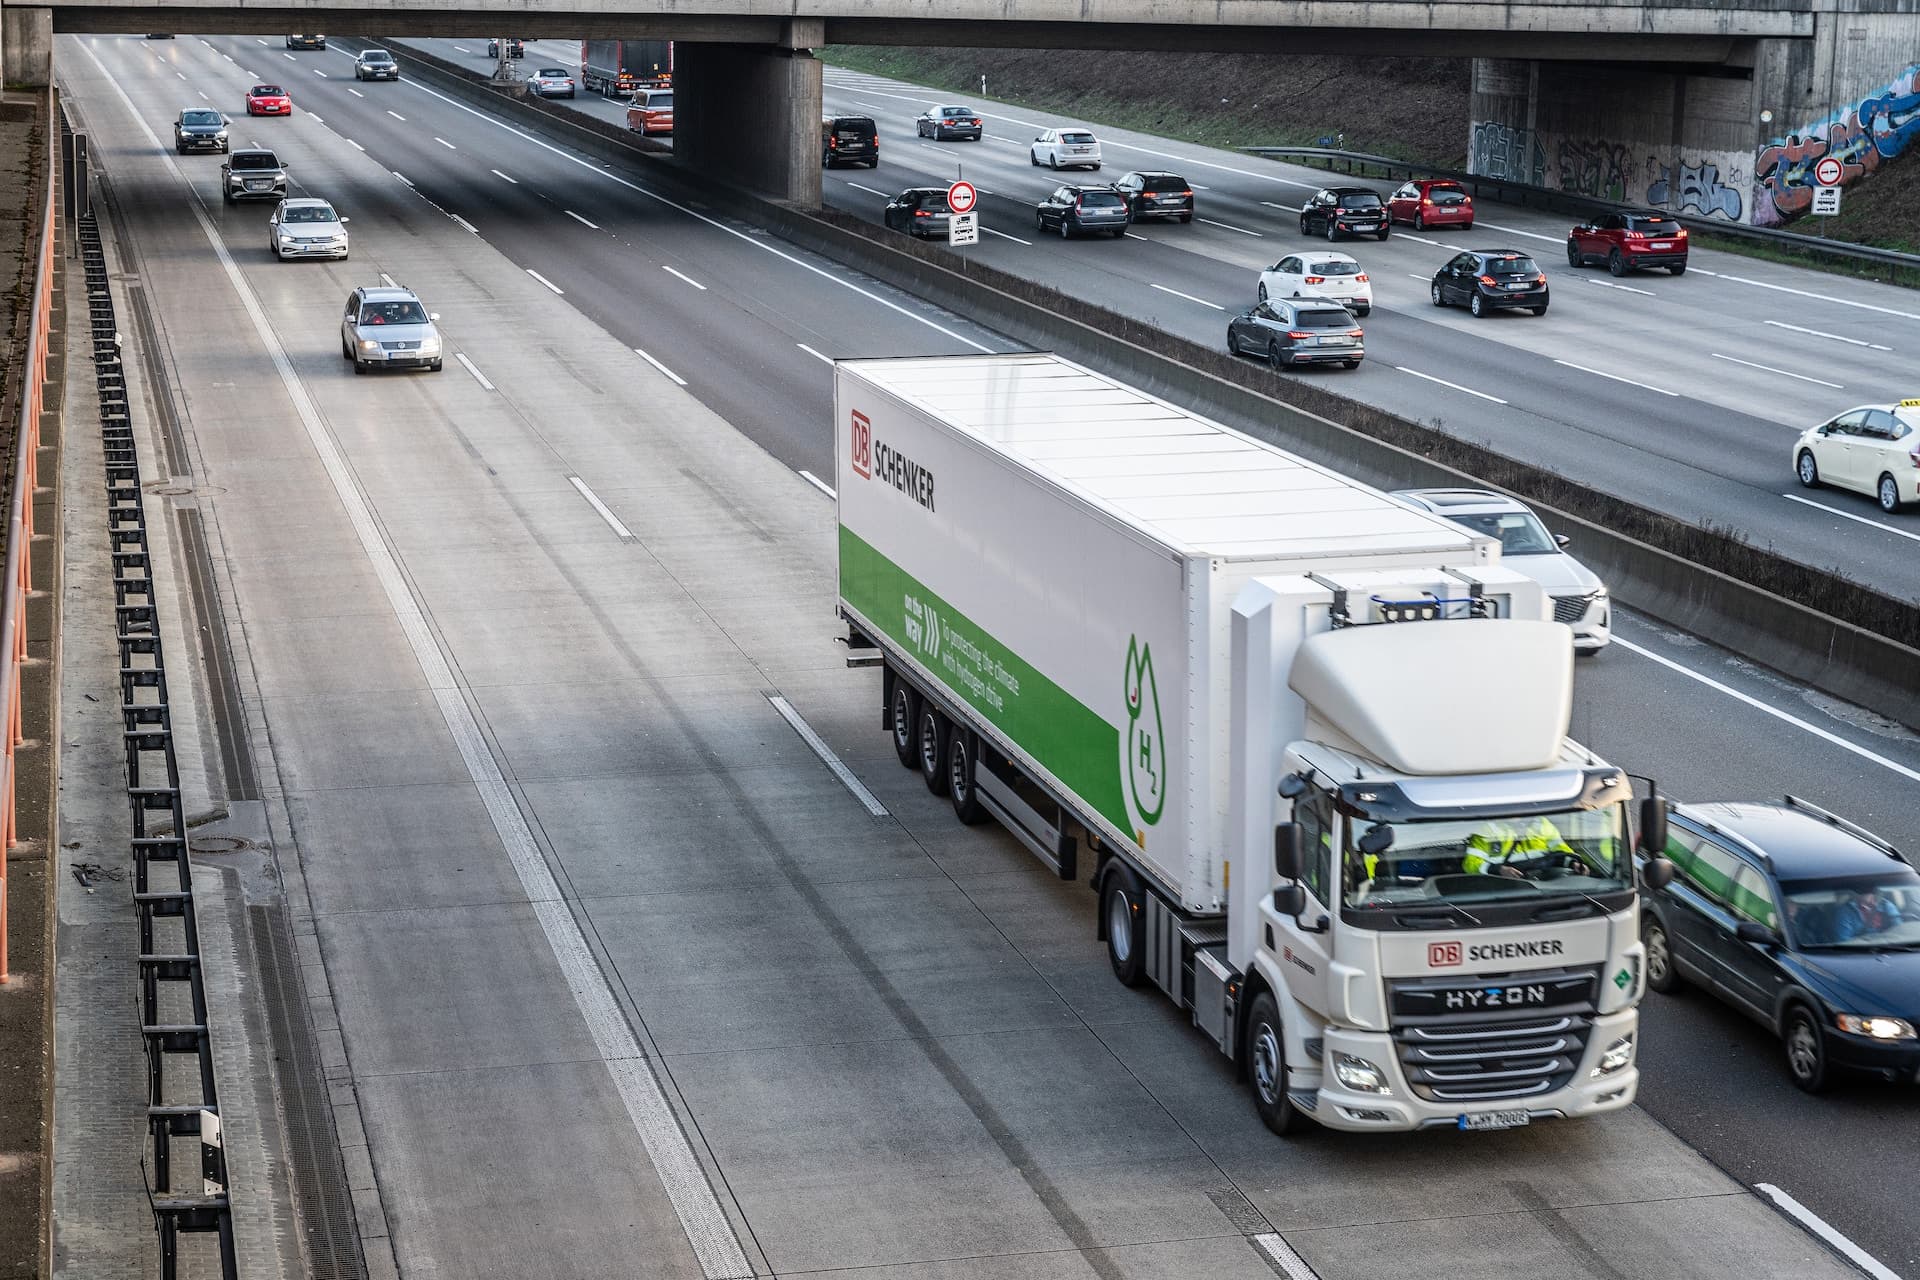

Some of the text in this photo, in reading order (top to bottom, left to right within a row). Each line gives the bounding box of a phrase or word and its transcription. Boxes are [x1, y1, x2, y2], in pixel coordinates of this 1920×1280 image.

[853, 416, 935, 513] DB SCHENKER
[905, 614, 922, 653] way
[1431, 940, 1564, 964] DB SCHENKER
[1446, 985, 1545, 1009] HYZON
